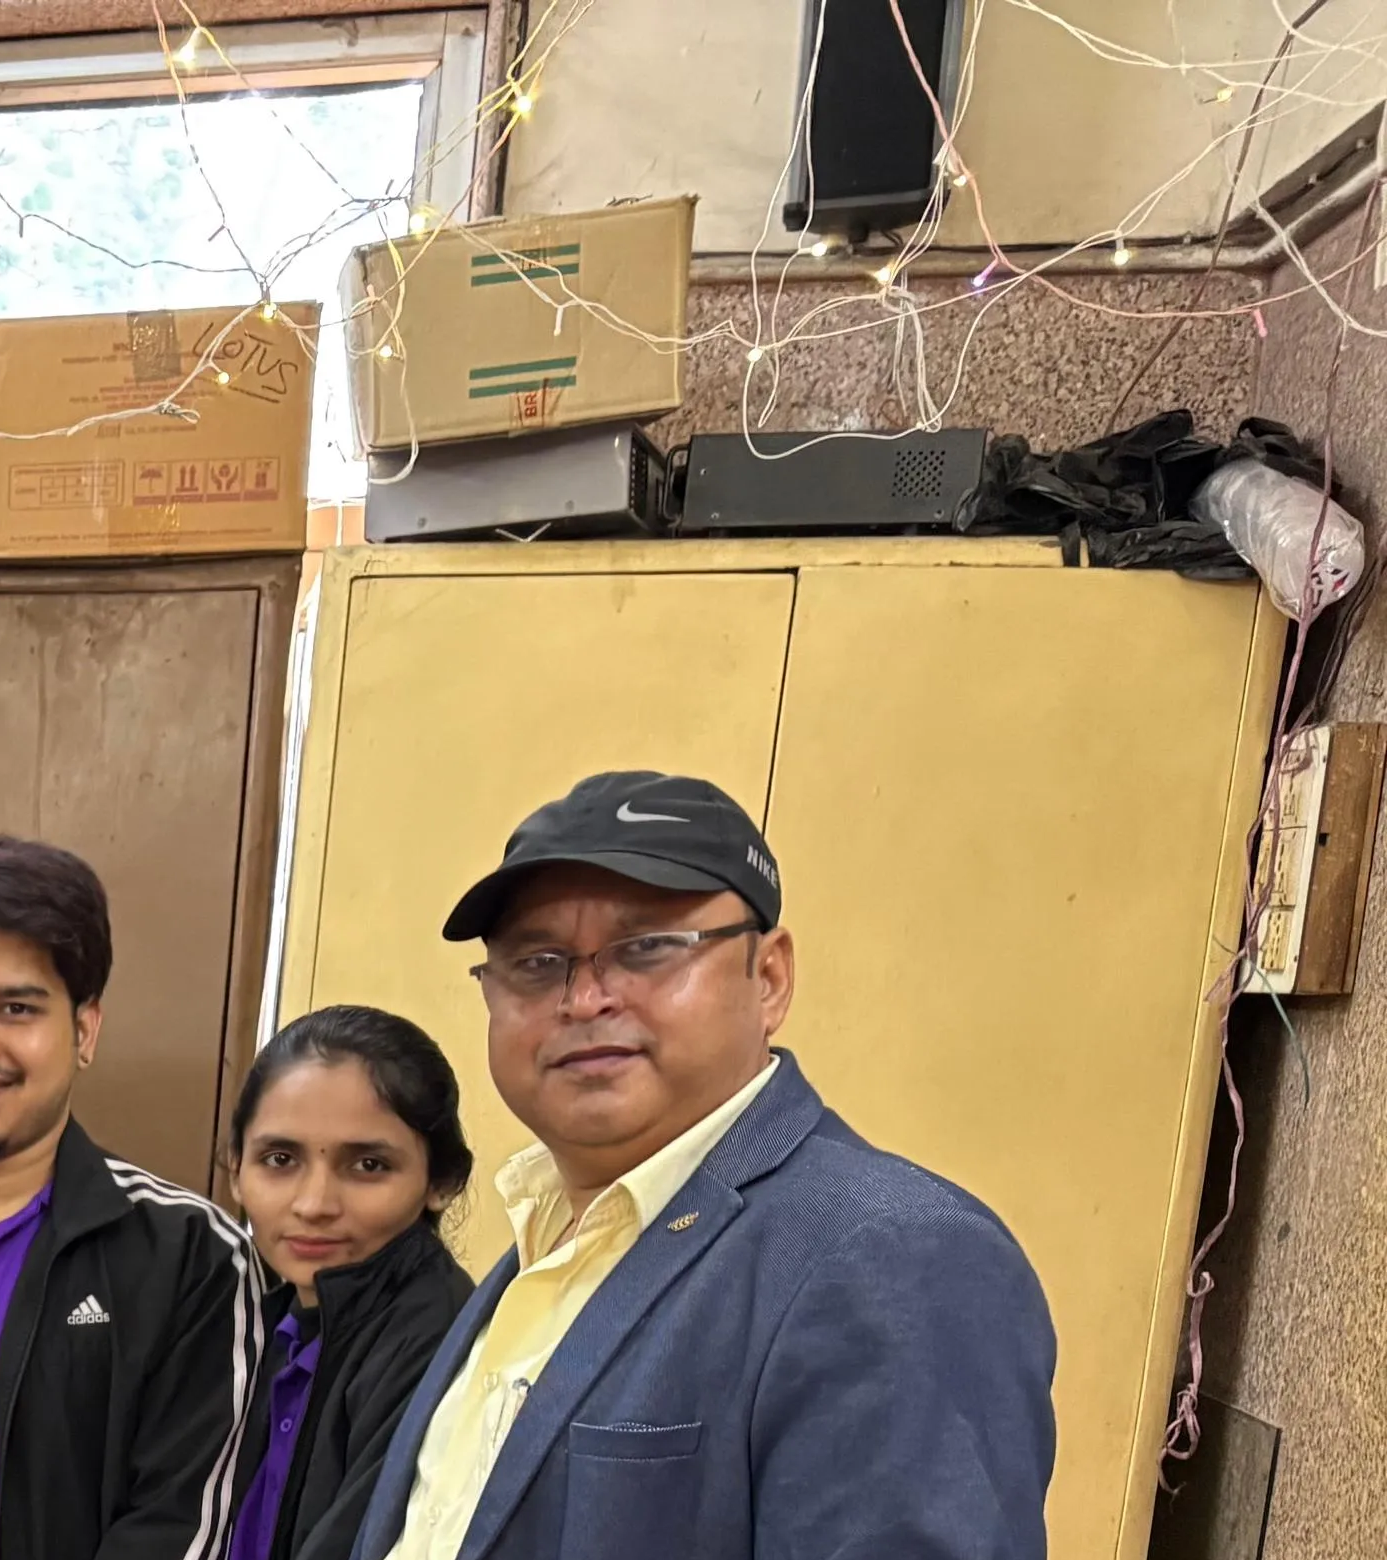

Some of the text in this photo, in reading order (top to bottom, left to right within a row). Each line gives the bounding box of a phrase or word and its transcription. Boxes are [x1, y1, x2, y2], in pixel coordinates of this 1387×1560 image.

[192, 322, 298, 395] LOTUS
[746, 844, 778, 890] NIKE
[67, 1311, 110, 1325] adidas
